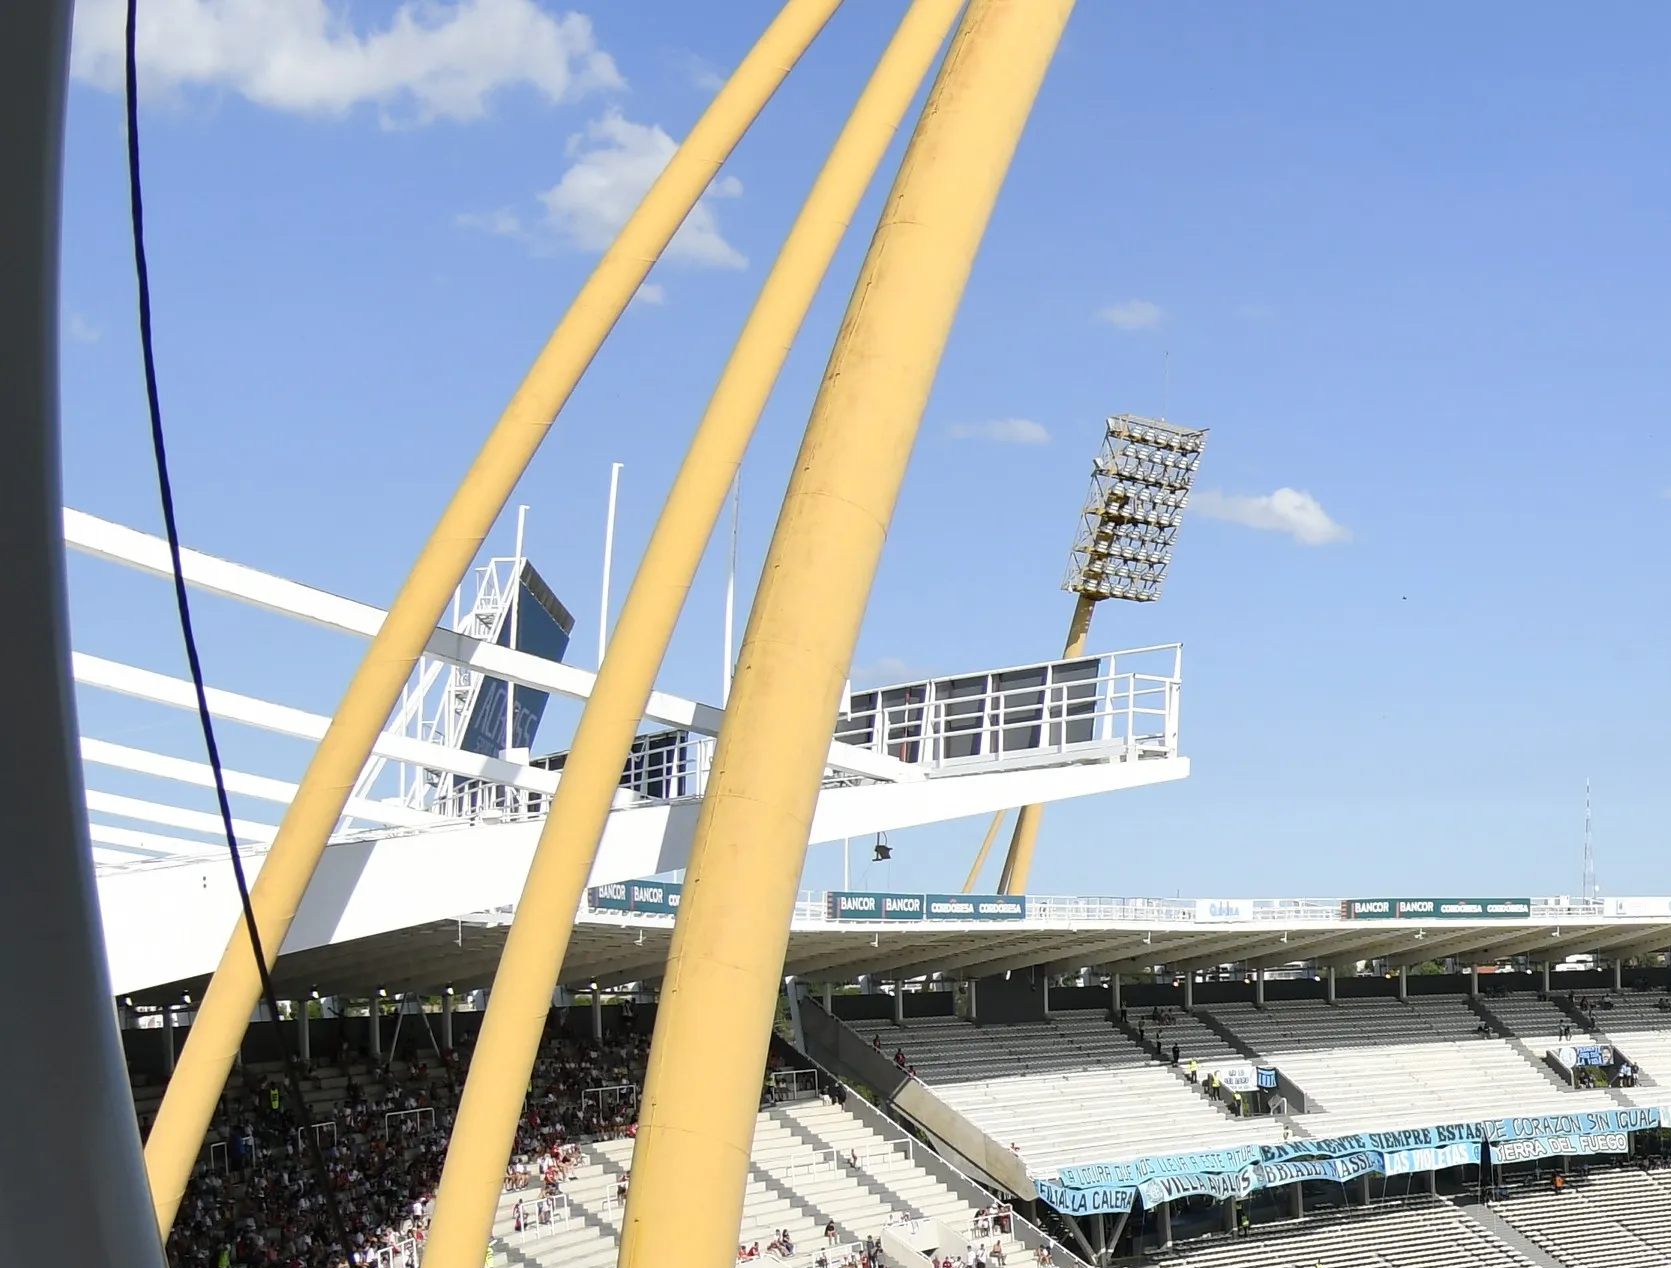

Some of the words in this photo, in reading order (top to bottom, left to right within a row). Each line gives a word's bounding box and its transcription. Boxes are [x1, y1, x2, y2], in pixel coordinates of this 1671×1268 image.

[841, 897, 876, 911] BANCOR
[885, 897, 920, 911] BANCOR
[1485, 1119, 1506, 1139] DE
[1512, 1114, 1581, 1137] CORAZON
[1589, 1111, 1611, 1130] SIN
[1614, 1107, 1657, 1129] IGUAL
[1369, 1127, 1432, 1151] SIEMPRE
[1437, 1122, 1483, 1143] ESTAS
[1551, 1137, 1578, 1155] DEL
[1581, 1132, 1627, 1153] FUEGO
[1162, 1173, 1206, 1197] VILLA
[1071, 1190, 1087, 1212] LA
[1092, 1188, 1132, 1211] CALERA
